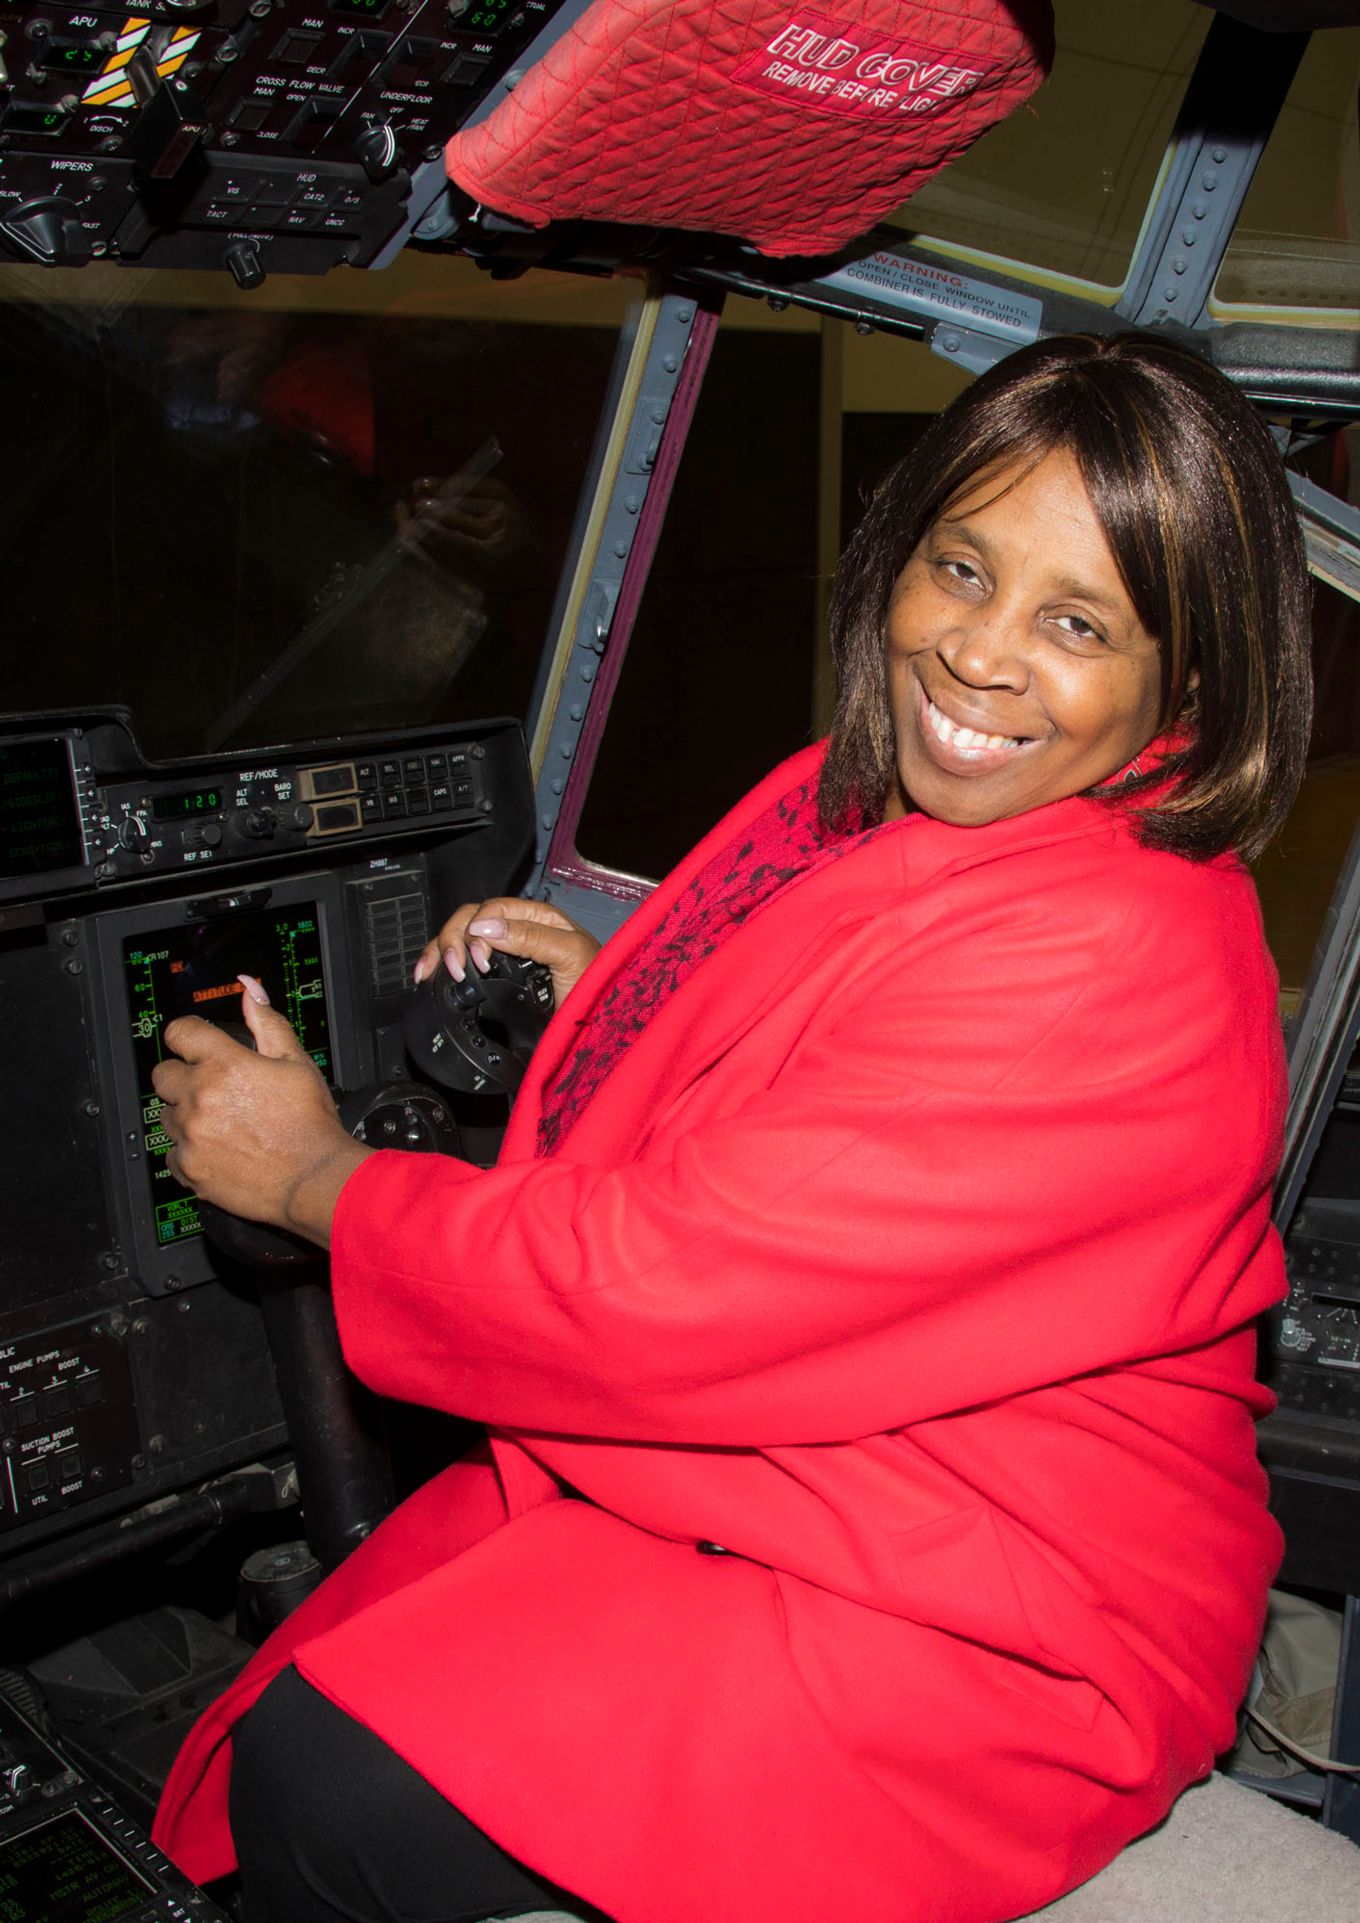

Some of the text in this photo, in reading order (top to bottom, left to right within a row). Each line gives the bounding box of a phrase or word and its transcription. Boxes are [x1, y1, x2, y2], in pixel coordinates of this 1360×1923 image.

[69, 16, 97, 27] APU
[302, 18, 323, 28] MAN
[472, 43, 492, 53] MAN
[767, 23, 859, 70] HUD
[762, 61, 836, 95] REMOVE
[256, 76, 345, 93] CROSS FLOW VALVE
[253, 86, 275, 96] MAN
[380, 91, 433, 104] UNDERFLOOR
[90, 125, 114, 133] DISCH
[51, 160, 94, 172] WIPERS
[296, 173, 316, 182] HUD
[206, 210, 228, 218] TACT
[858, 260, 892, 276] OPEN
[900, 272, 939, 290] CLOSE
[945, 286, 995, 307] WINDOW
[997, 302, 1031, 318] UNTIL
[847, 267, 1022, 328] COMBINER IS FULLY STOWED
[236, 788, 248, 797] ALT
[277, 791, 290, 800] SET
[185, 793, 217, 809] 120
[236, 797, 249, 806] SEL
[183, 852, 197, 862] REF
[9, 1350, 61, 1374] ENGINE PUMPS
[57, 1356, 80, 1371] BOOST
[21, 1426, 75, 1452] SUCTION BOOST
[37, 1440, 61, 1454] PUMPS
[61, 1480, 83, 1495] BOOST
[31, 1494, 49, 1506] UTIL
